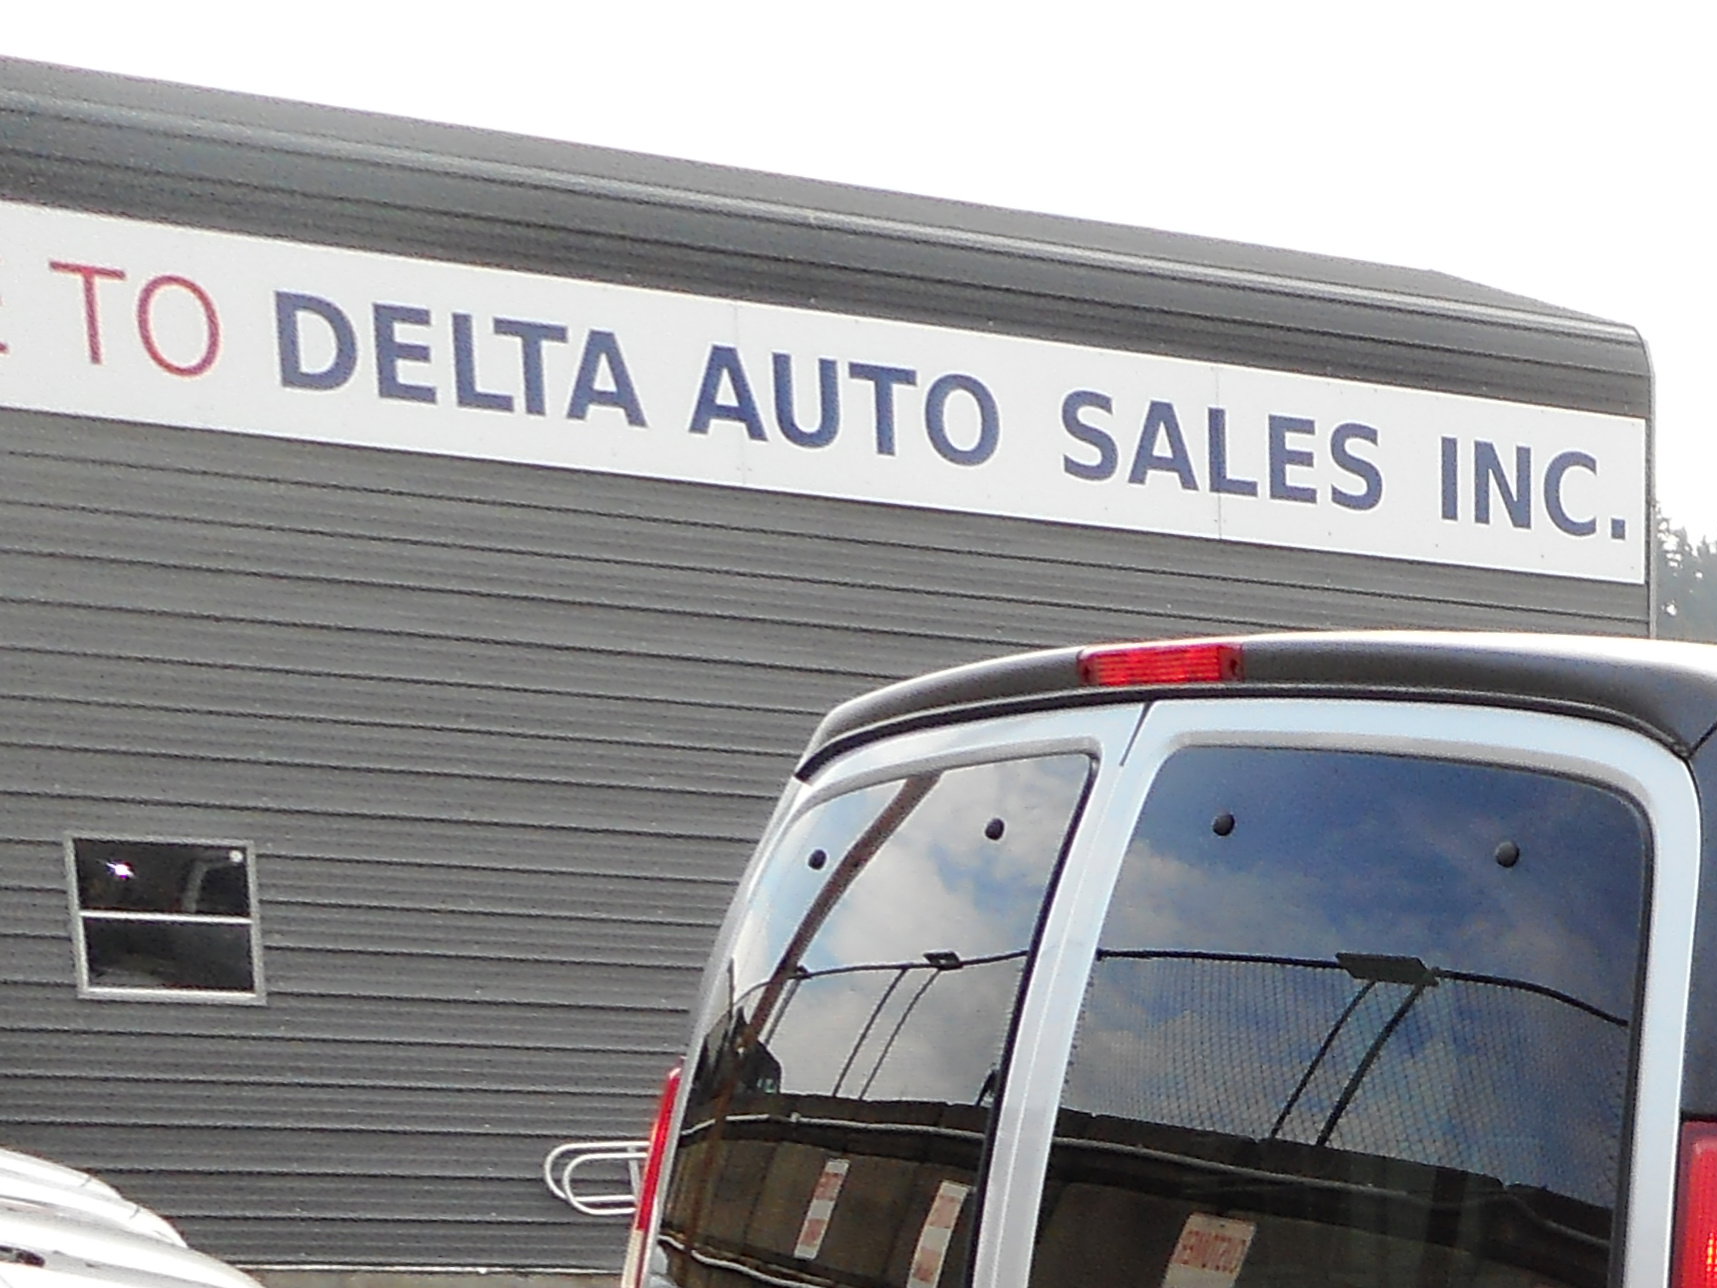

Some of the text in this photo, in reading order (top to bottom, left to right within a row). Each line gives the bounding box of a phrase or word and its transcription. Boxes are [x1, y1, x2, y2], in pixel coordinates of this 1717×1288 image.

[49, 260, 1627, 540] TO DELTA AUTO SALES INC.
